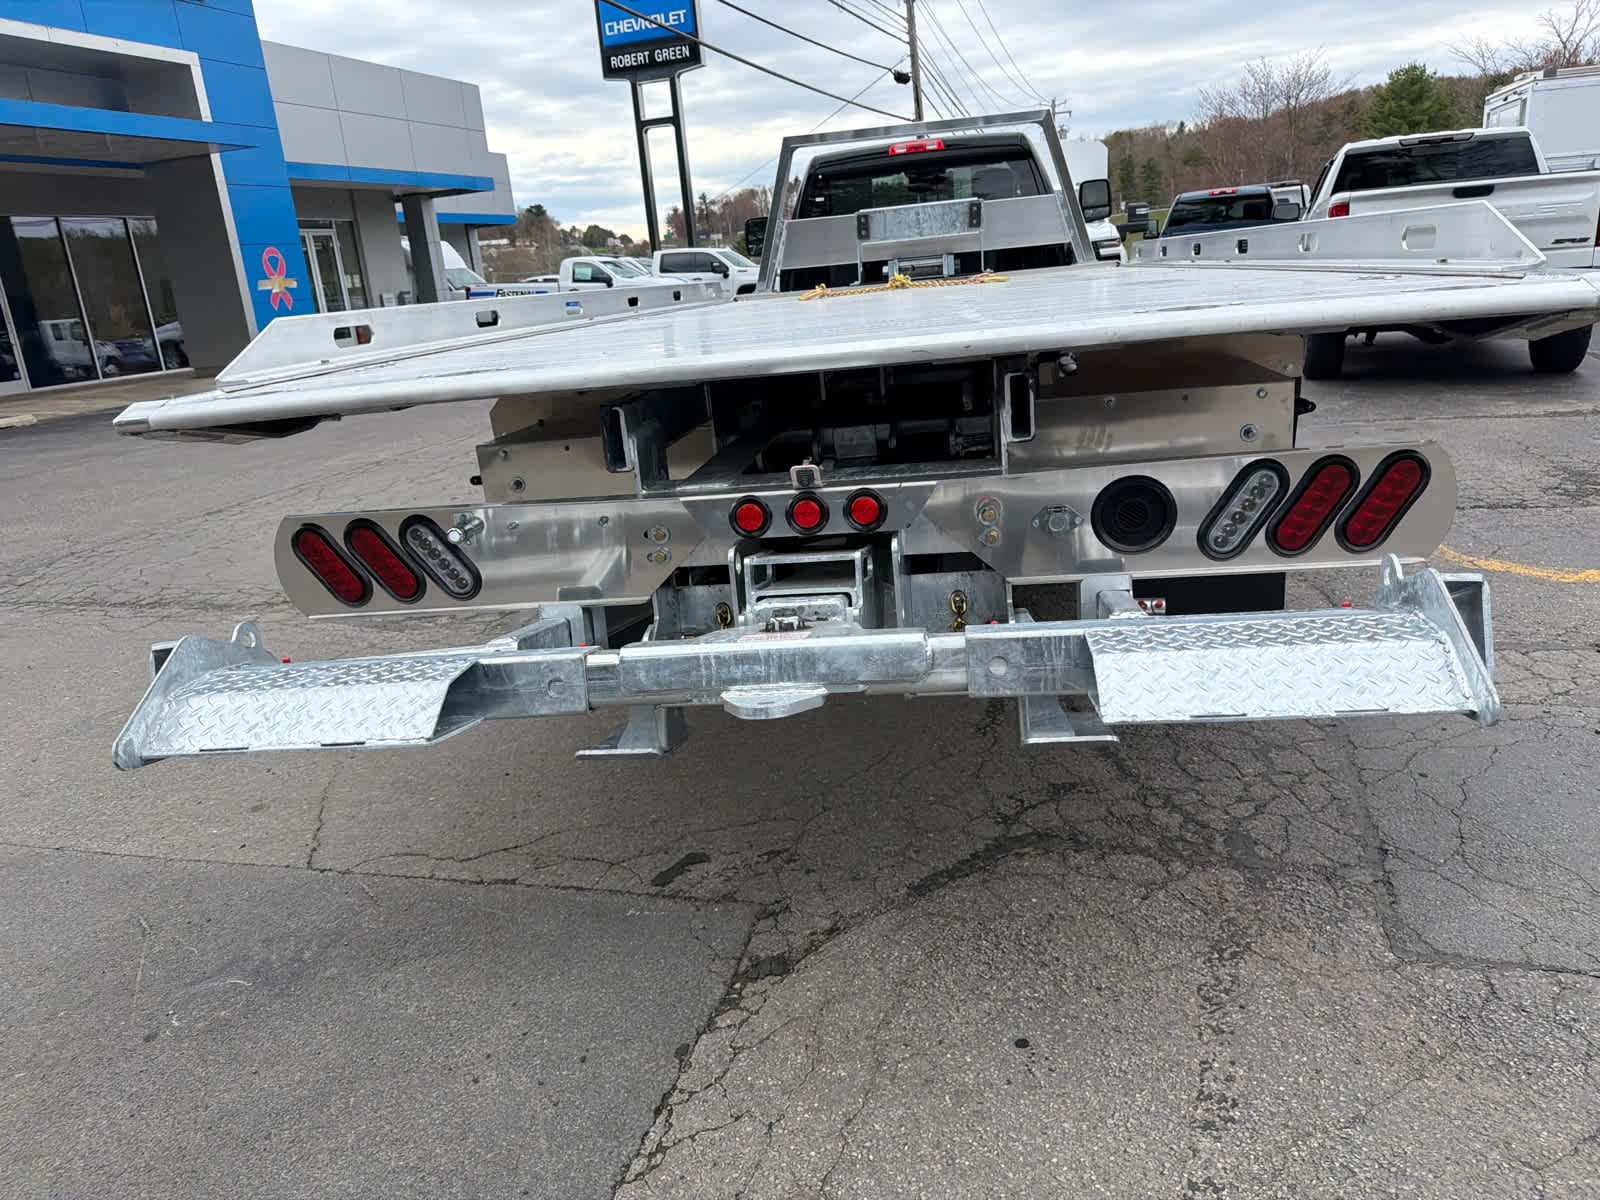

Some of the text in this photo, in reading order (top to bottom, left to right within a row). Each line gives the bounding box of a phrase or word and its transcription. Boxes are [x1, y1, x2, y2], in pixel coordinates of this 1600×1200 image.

[605, 9, 687, 36] CHEVROLET
[610, 45, 690, 69] ROBERT GREEN
